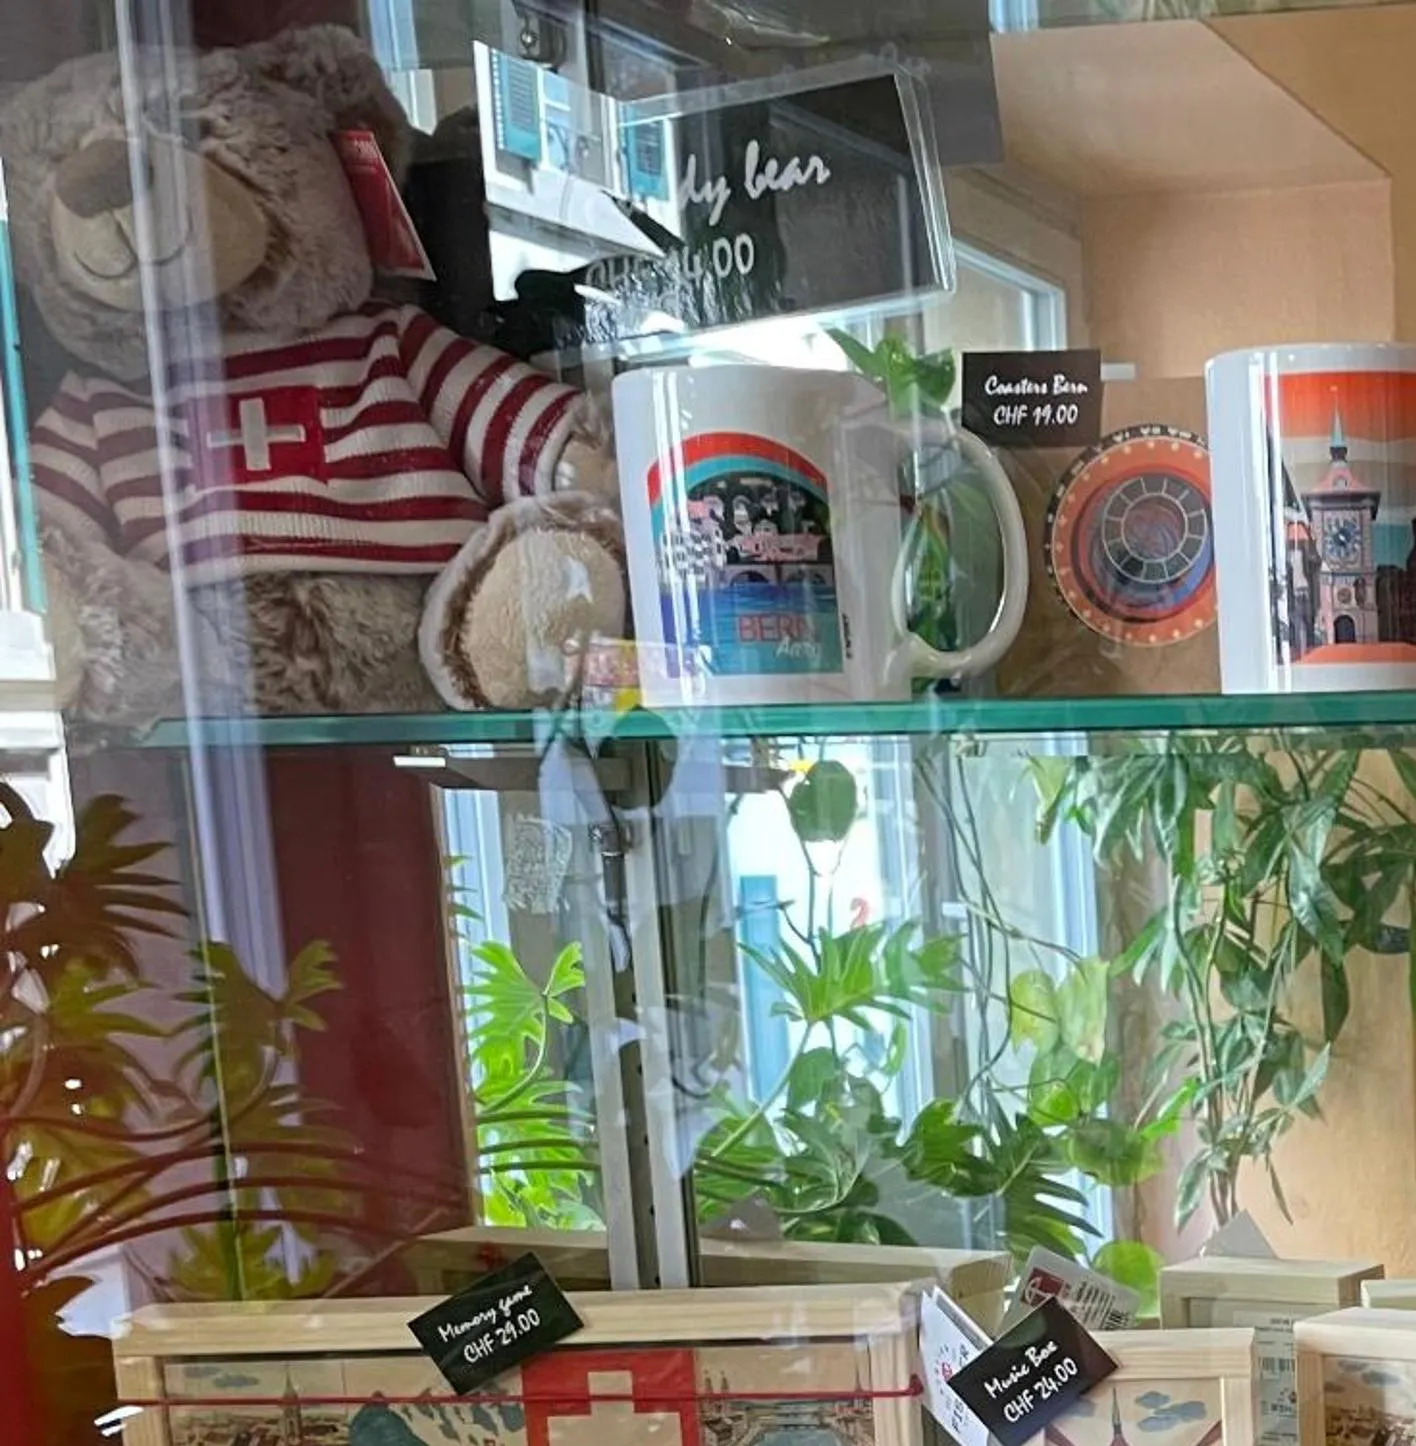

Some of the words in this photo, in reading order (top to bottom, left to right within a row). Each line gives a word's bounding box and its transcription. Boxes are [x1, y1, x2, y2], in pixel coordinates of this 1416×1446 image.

[744, 139, 831, 199] bear
[984, 375, 1048, 395] Coasters
[1052, 373, 1088, 395] Bern
[993, 404, 1028, 425] CHF
[1032, 404, 1079, 426] 19.00
[438, 1307, 497, 1343] Memory
[499, 1284, 534, 1317] game
[463, 1332, 495, 1363] CHF
[494, 1307, 541, 1346] 29.00
[984, 1362, 1031, 1399] Music
[1024, 1340, 1060, 1368] Box
[1003, 1388, 1036, 1423] CHF
[1033, 1357, 1079, 1399] 24.00
